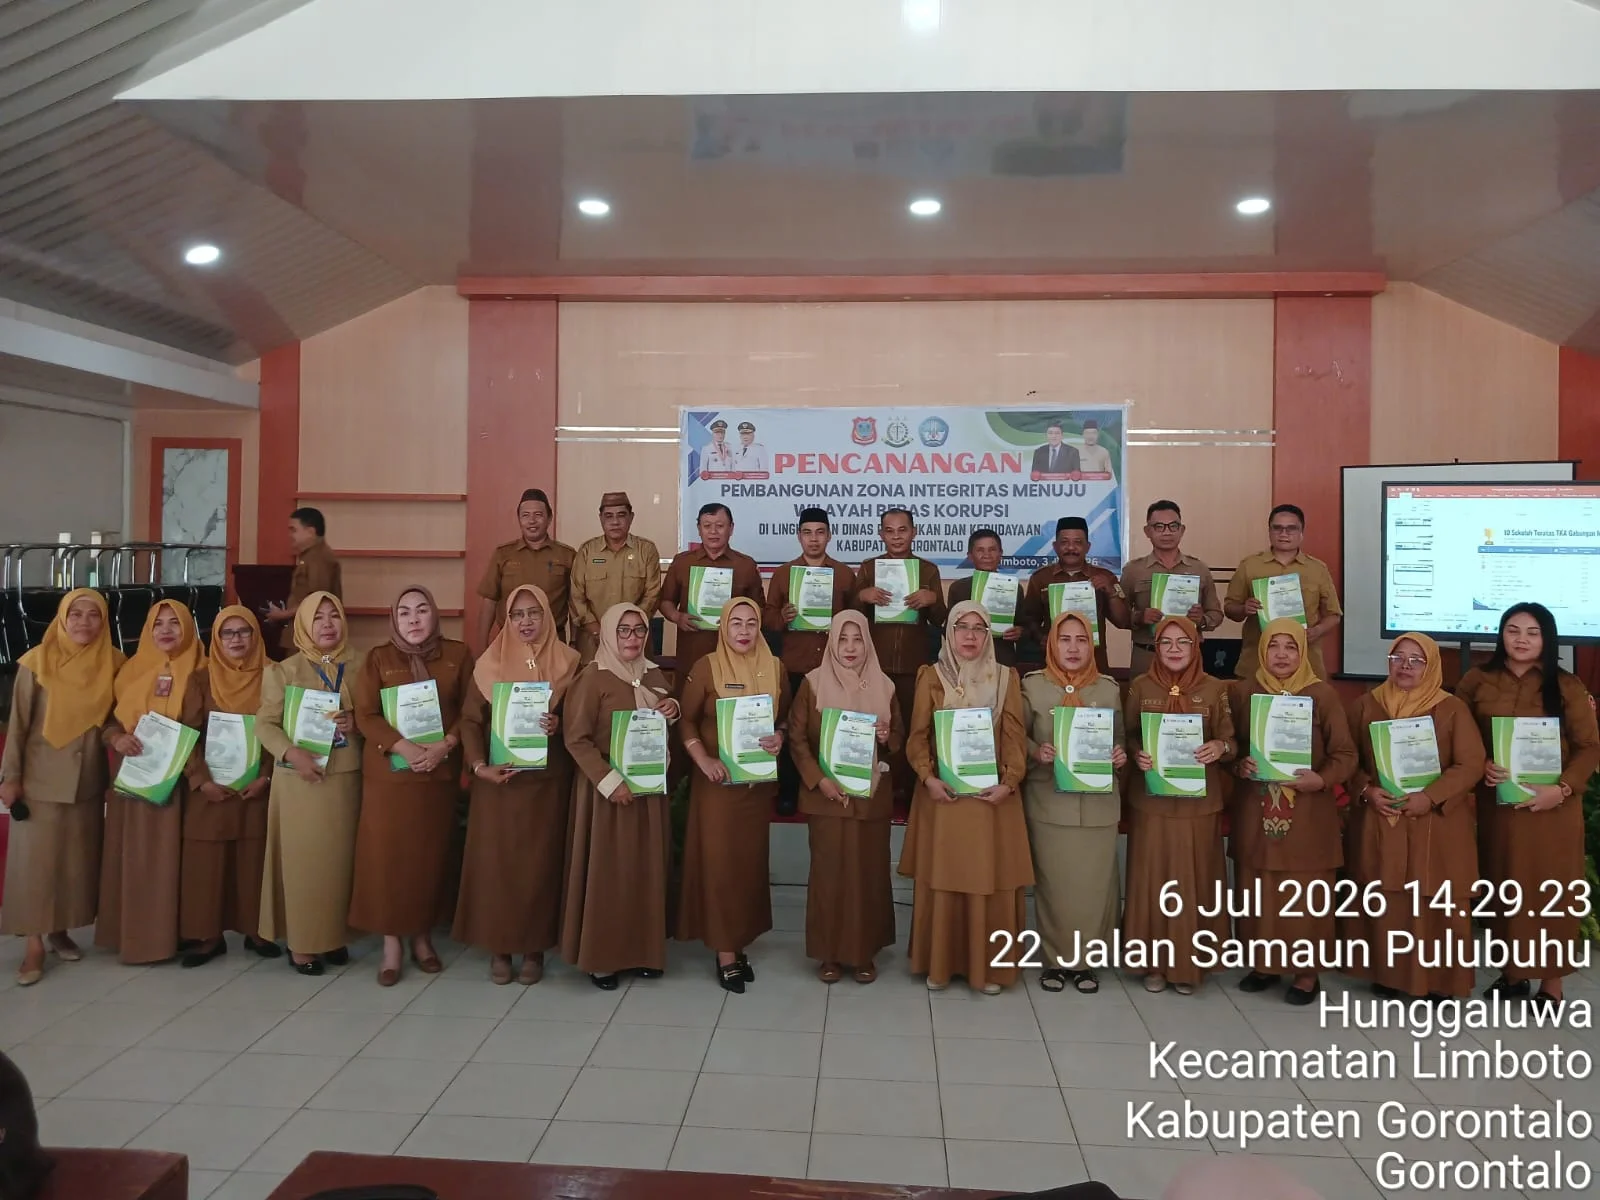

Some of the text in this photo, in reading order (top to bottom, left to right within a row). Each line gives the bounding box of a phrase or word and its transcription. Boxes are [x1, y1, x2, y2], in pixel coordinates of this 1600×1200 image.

[774, 452, 1022, 474] PENCANANGAN
[720, 483, 1086, 497] PEMBANGUNAN ZONA INTEGRITAS MENUJU
[934, 503, 1009, 518] KORUPSI
[758, 523, 769, 536] DI
[842, 523, 874, 536] DINAS
[944, 523, 966, 536] DAN
[1000, 556, 1040, 567] imboto,
[1041, 557, 1049, 566] 3
